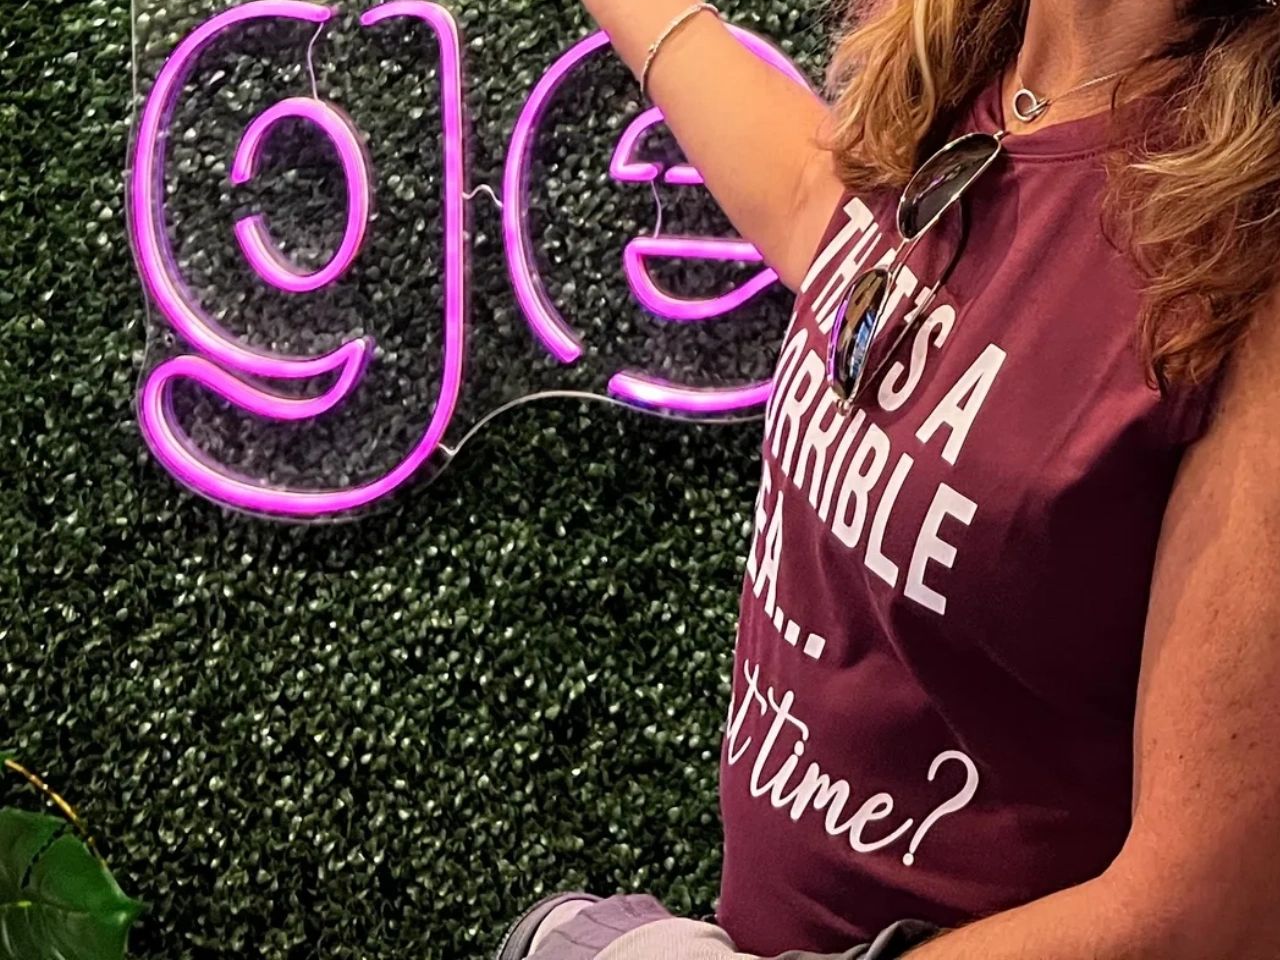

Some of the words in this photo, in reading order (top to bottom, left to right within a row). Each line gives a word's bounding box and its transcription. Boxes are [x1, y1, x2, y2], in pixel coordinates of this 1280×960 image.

[764, 310, 979, 617] ORRIBLE
[915, 342, 1007, 466] A
[749, 686, 980, 867] time?
